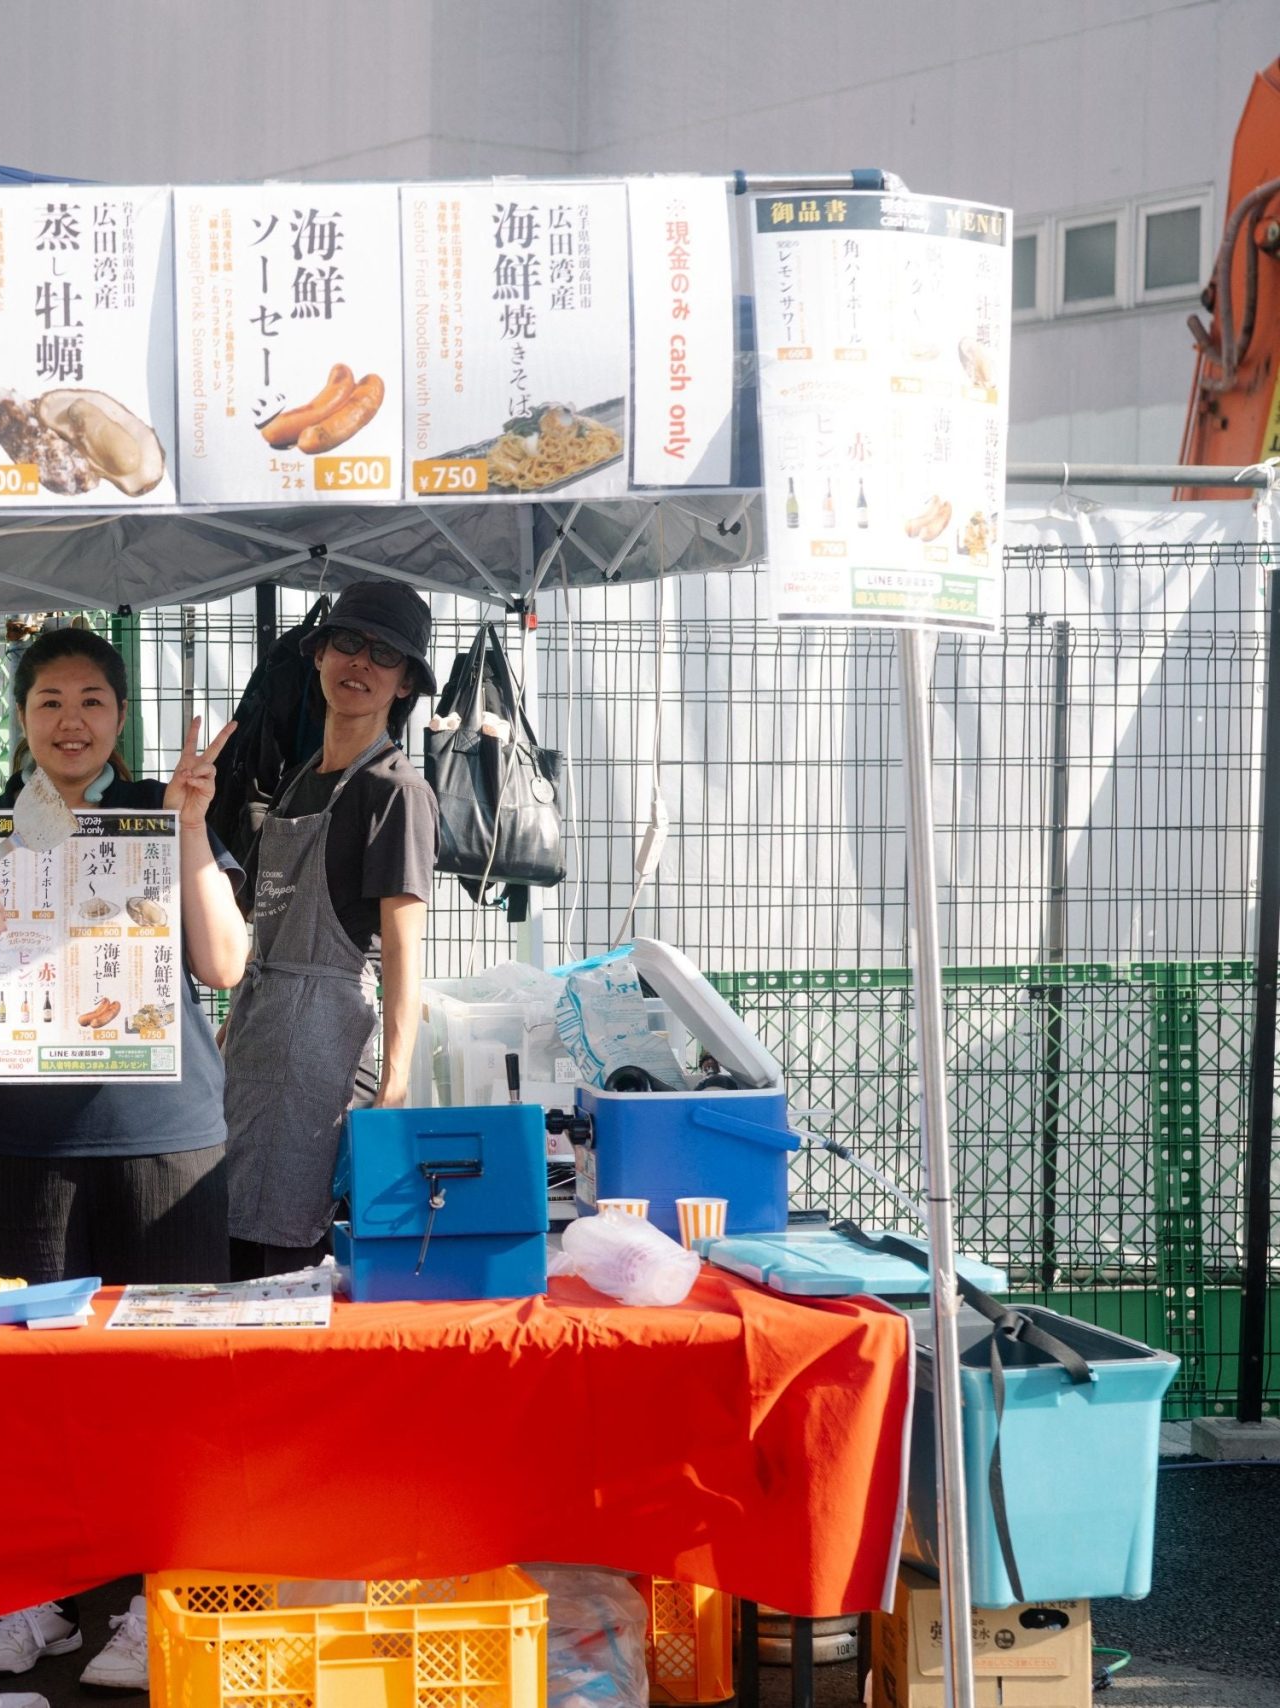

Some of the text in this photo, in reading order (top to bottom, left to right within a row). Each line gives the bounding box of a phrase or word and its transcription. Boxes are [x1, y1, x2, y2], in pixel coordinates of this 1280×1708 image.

[771, 199, 848, 224] 御品書
[946, 209, 1003, 236] MENU
[93, 202, 120, 310] 広田湾産
[289, 208, 346, 320] 海鮮
[415, 258, 430, 298] Fried
[549, 204, 575, 312] 広田湾産
[35, 202, 84, 383] 蒸し牡蠣
[491, 201, 543, 418] 海鮮焼きそば
[777, 250, 796, 342] レモンサワー
[842, 239, 863, 344] 角ハイボール
[249, 214, 287, 431] ソーセージ
[415, 304, 431, 369] Noodles
[191, 328, 207, 398] Seaweed
[670, 334, 692, 392] cash
[416, 372, 431, 407] with
[417, 412, 432, 450] Miso
[664, 403, 692, 460] only
[324, 460, 385, 486] ¥500
[867, 575, 893, 586] LINE
[87, 827, 105, 836] only
[119, 818, 170, 832] MENU
[99, 841, 117, 875] 帆立
[143, 842, 161, 902] 蒸し牡蠣
[1, 858, 11, 907] モンサワー
[257, 880, 296, 899] Pepper
[38, 962, 57, 982] 赤
[103, 943, 121, 979] 海鮮
[49, 1050, 69, 1058] LINE
